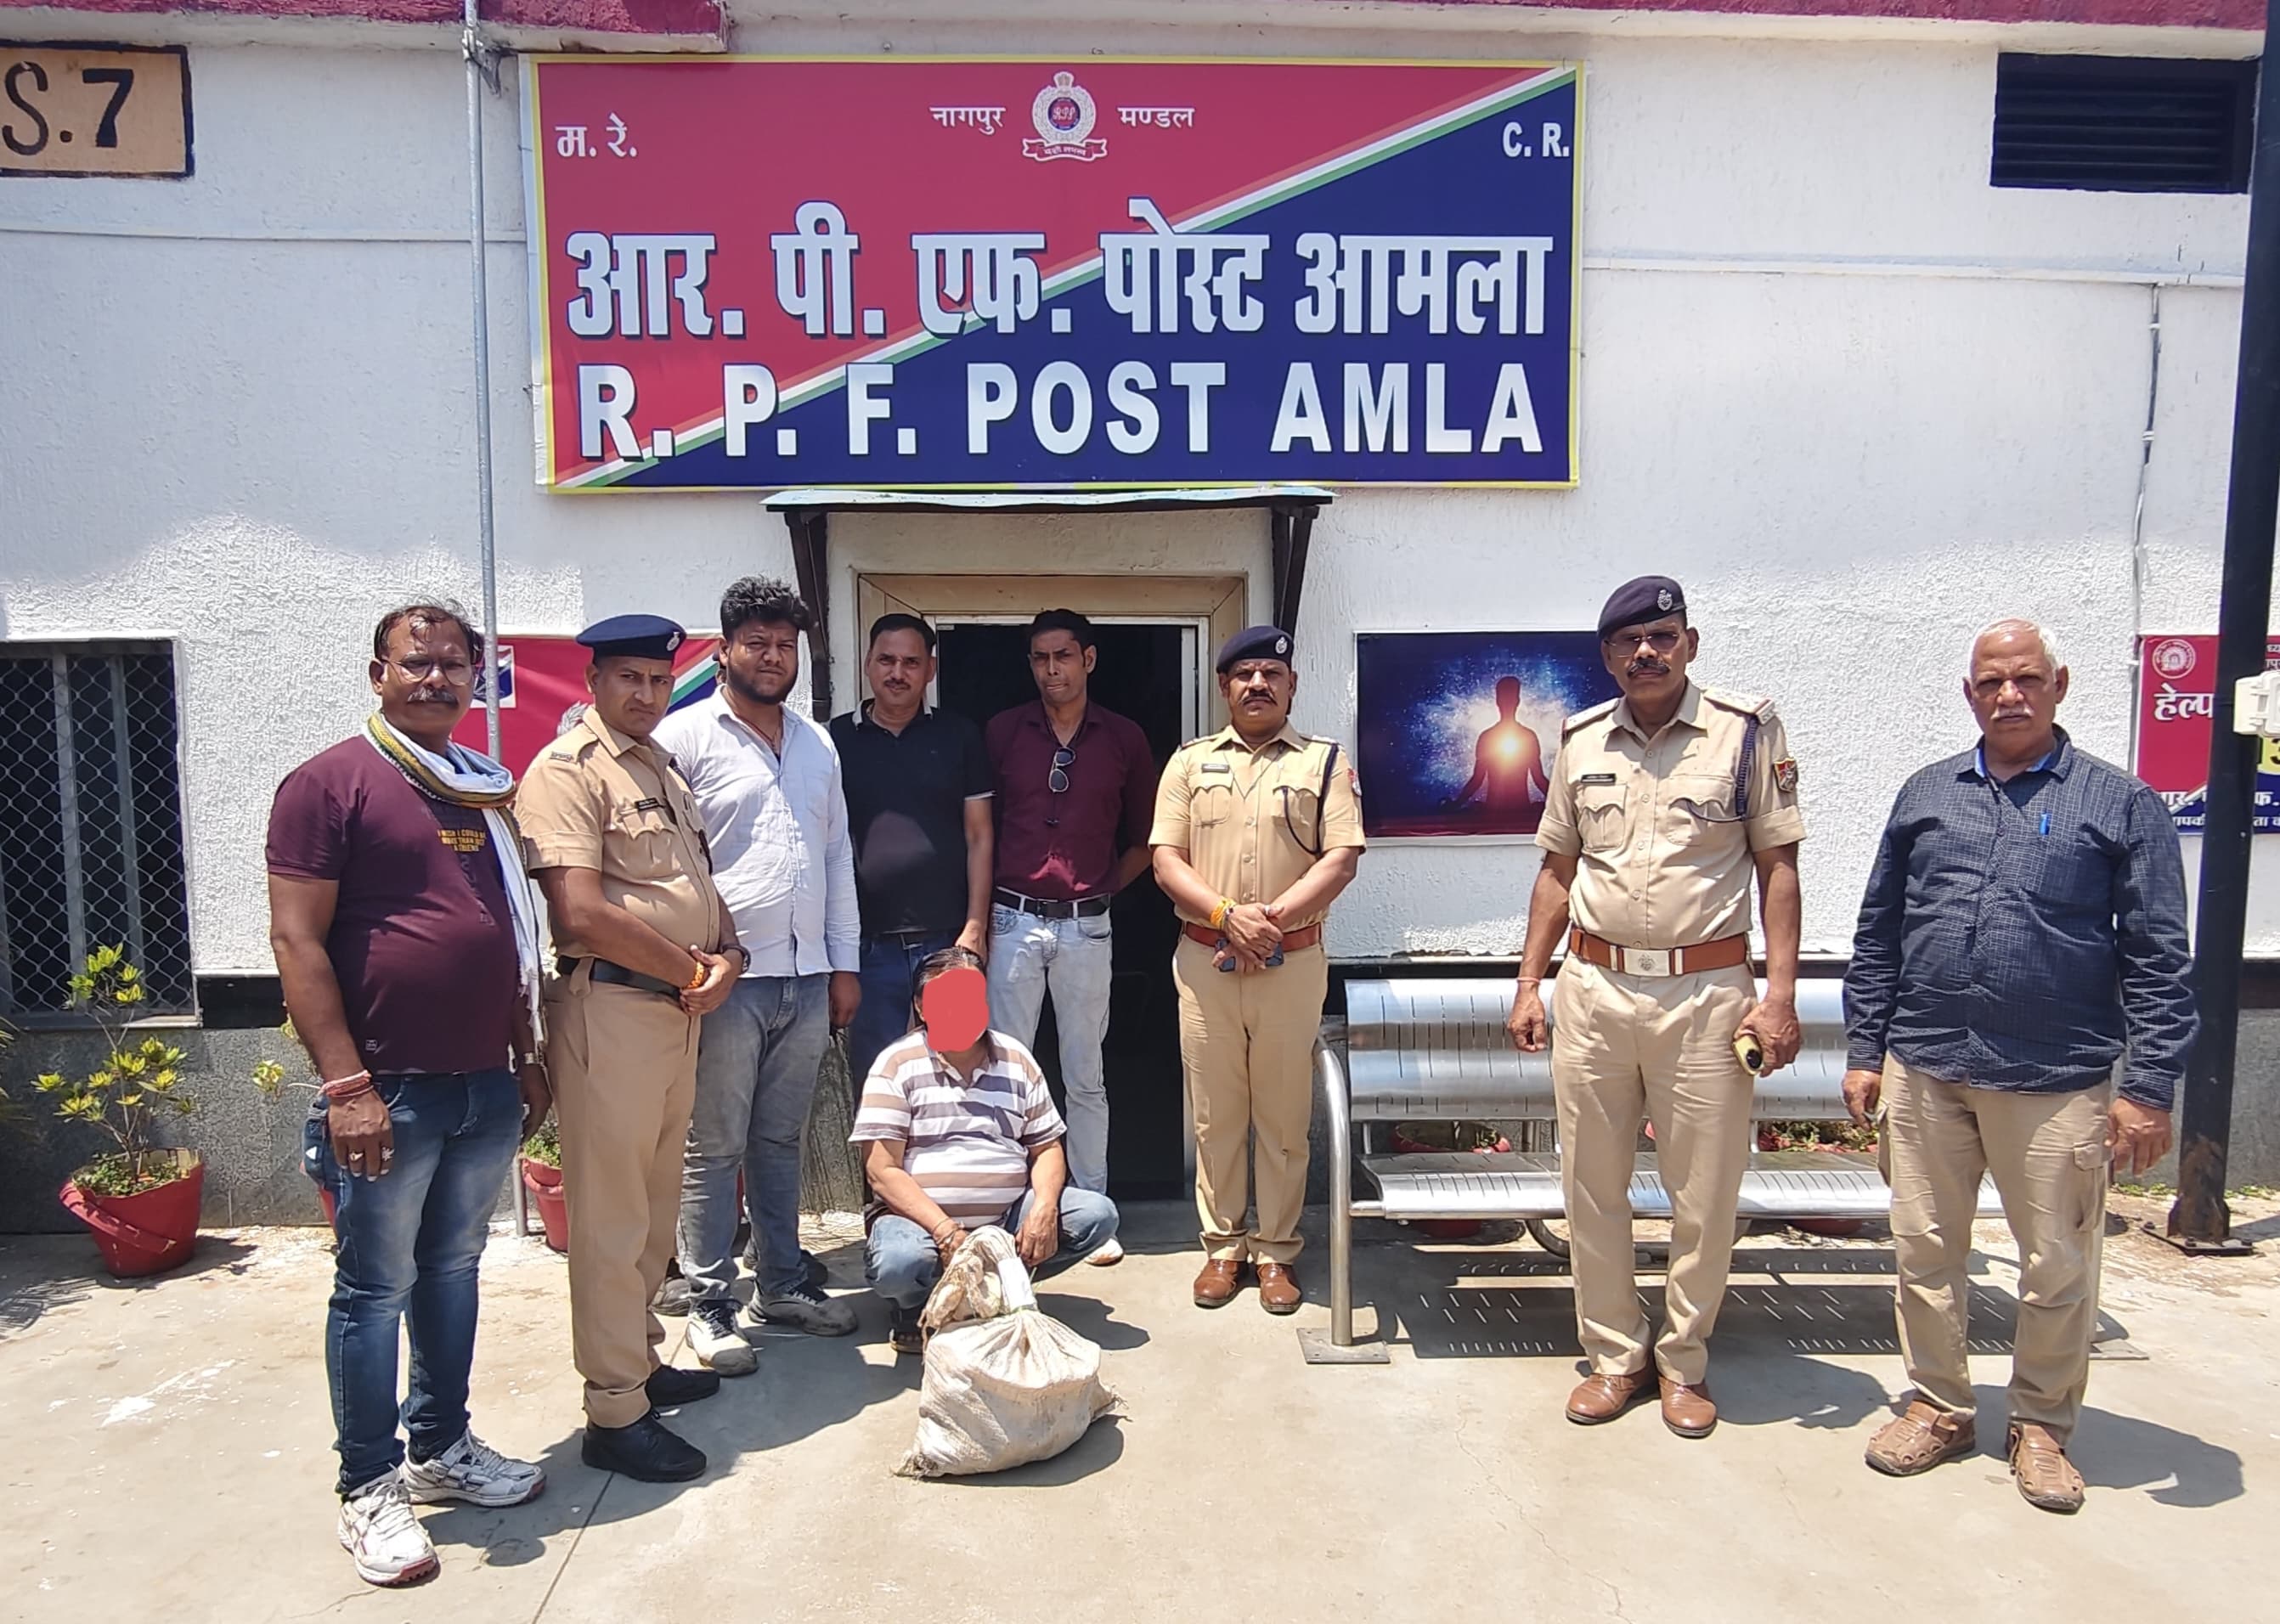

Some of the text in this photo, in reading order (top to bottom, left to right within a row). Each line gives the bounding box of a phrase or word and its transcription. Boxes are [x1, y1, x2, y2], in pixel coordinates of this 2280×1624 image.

[555, 112, 637, 157] म. रे.
[929, 106, 1194, 135] नागपुर मण्डल
[1503, 121, 1570, 157] C. R.
[567, 199, 1554, 337] आर. पी. एफ. पोस्ट आमला
[578, 361, 1544, 458] R. P. F. POST AMLA
